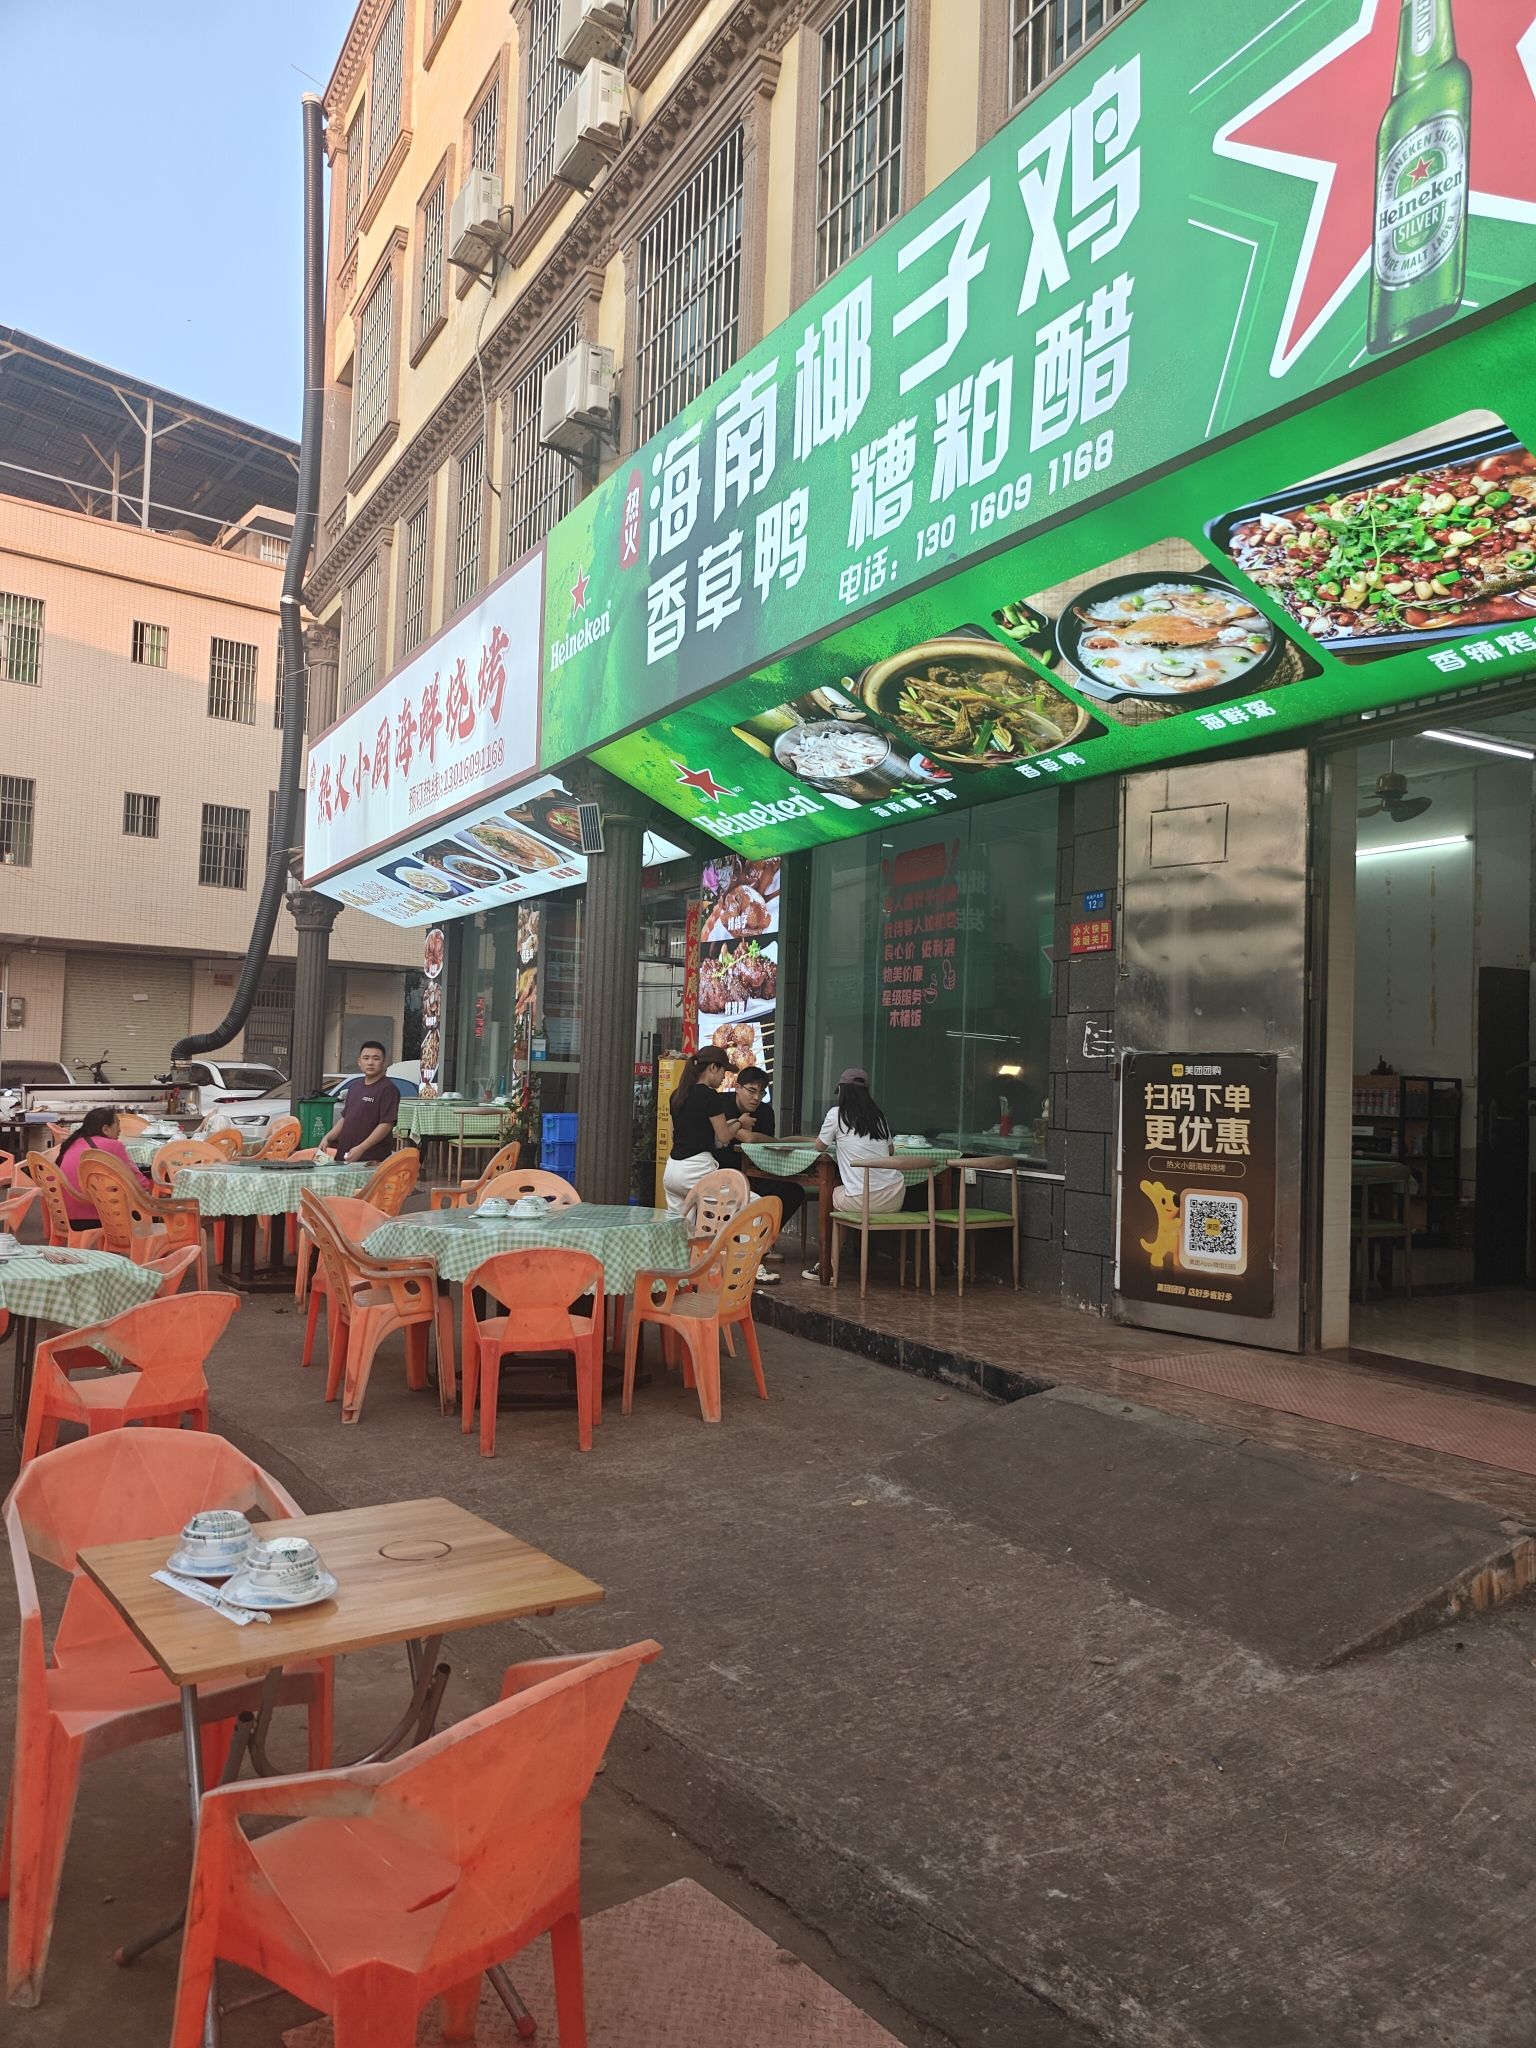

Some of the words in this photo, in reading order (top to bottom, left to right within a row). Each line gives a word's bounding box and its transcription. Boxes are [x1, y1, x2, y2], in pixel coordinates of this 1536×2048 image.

[1385, 133, 1432, 192] HEINEKEN
[1433, 129, 1458, 153] SILVER
[1379, 170, 1462, 230] Heineken
[1383, 251, 1399, 272] PURE
[1401, 249, 1428, 271] MALT
[1432, 216, 1456, 251] LAGER
[1398, 207, 1438, 243] SILVER
[647, 53, 1141, 566] 海南椰子鸡
[647, 487, 808, 665] 香草鸭
[847, 271, 1136, 552] 糟粕醋
[916, 514, 956, 562] 130
[970, 472, 1032, 535] 1609
[1049, 429, 1114, 496] 1168
[623, 487, 640, 561] 热火
[551, 610, 611, 672] Heineken
[1427, 626, 1536, 672] 香辣烤
[317, 626, 510, 823] 热火小厨海鲜烧烤
[1195, 700, 1276, 730] 海鲜粥
[1015, 751, 1086, 779] 香草鸭
[692, 794, 824, 837] Heineken
[870, 787, 957, 817] 海南椰子鸡
[1073, 922, 1109, 936] 小火快跑
[882, 965, 924, 983] 物美价廉
[882, 988, 923, 1007] 星级服务
[1185, 1065, 1222, 1076] 美团团购
[1144, 1083, 1251, 1113] 扫码下单
[1144, 1115, 1251, 1155] 更优惠
